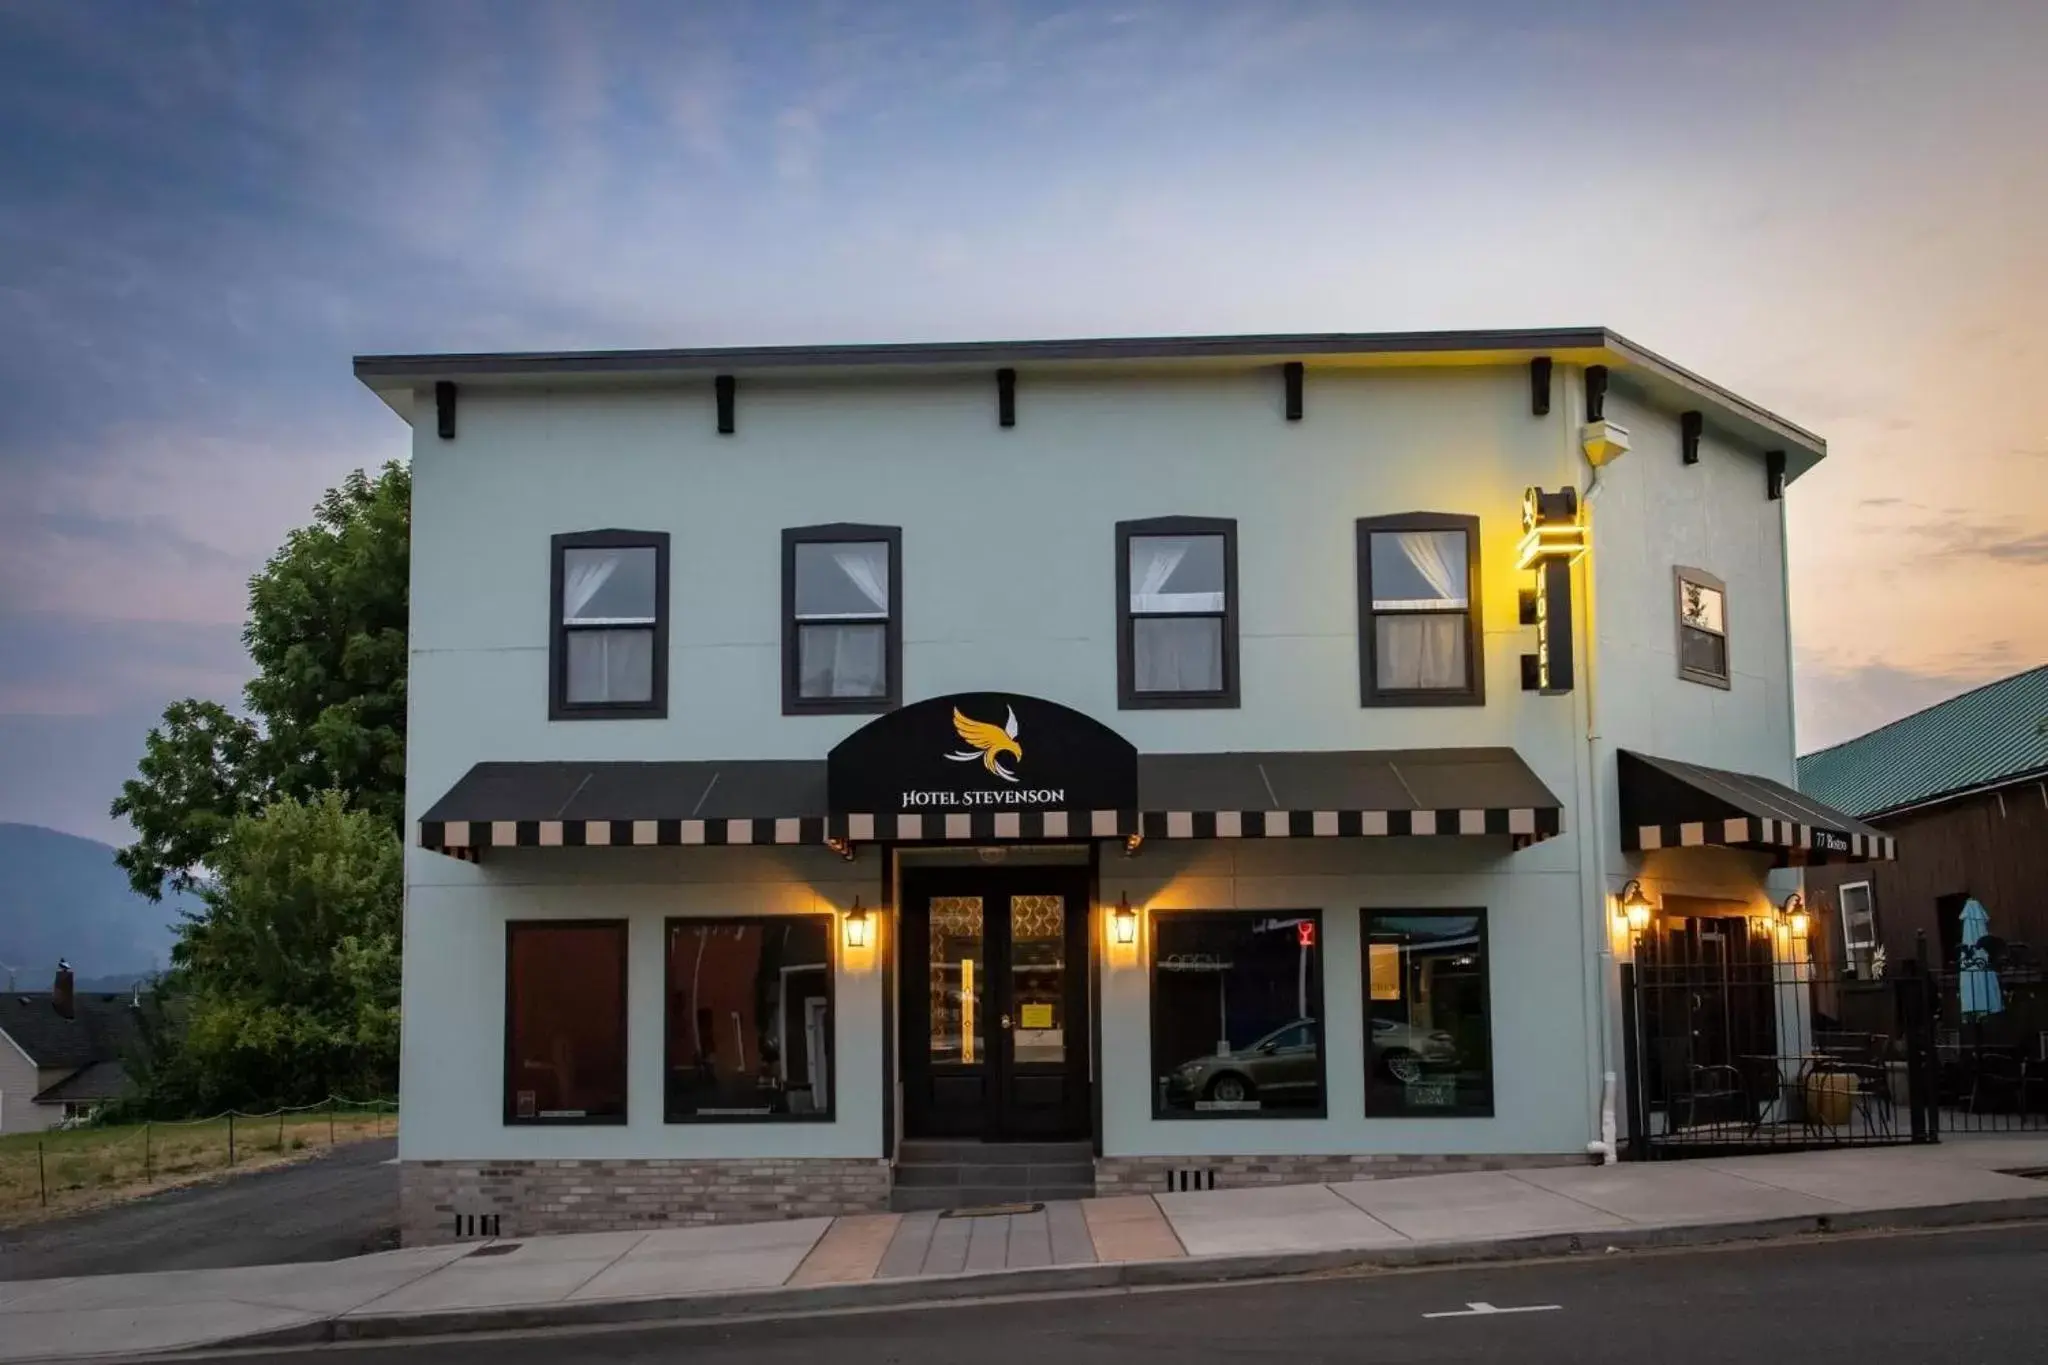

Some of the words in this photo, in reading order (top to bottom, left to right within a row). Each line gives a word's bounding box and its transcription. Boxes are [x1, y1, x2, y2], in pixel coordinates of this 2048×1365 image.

[902, 790, 959, 808] HOTEL
[962, 789, 1065, 806] STEVENSON
[1816, 832, 1825, 848] 77
